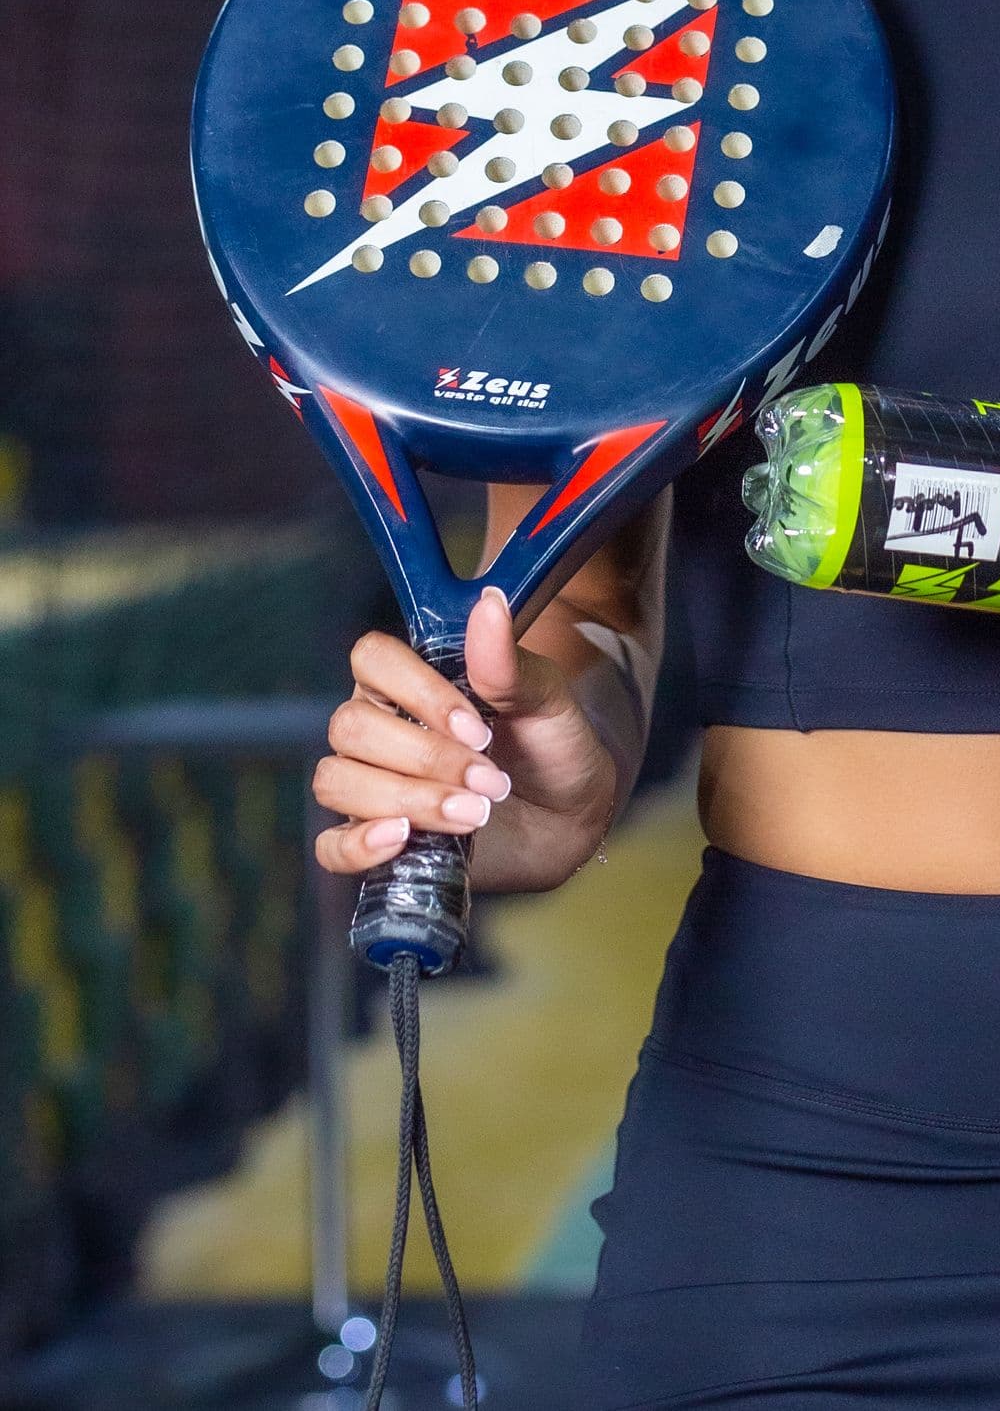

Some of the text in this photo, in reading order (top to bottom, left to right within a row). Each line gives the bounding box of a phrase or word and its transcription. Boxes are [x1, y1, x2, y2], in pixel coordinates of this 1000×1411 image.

[460, 370, 551, 399] Zeus
[434, 390, 486, 402] veste
[489, 396, 514, 407] gli
